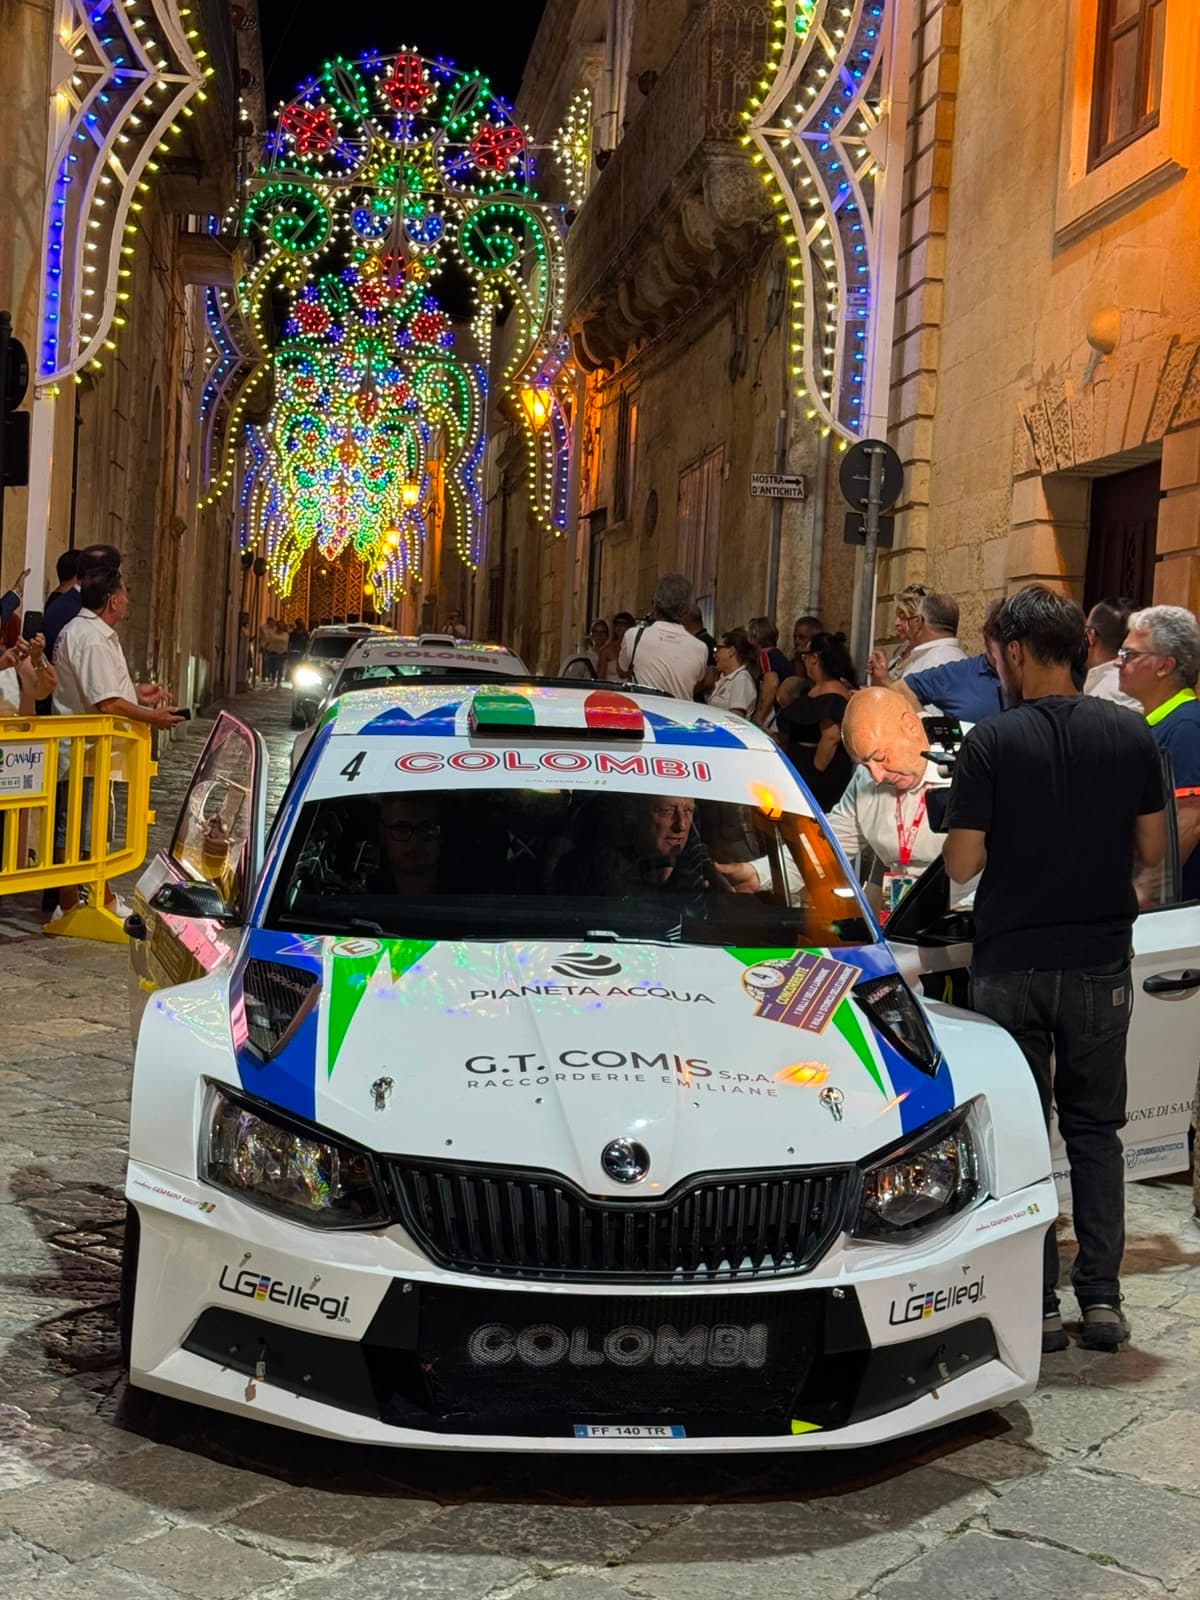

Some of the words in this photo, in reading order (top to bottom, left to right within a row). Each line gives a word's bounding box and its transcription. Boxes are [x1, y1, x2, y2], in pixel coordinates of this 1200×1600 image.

[752, 475, 785, 485] MOSTRA
[361, 650, 370, 659] 5
[384, 651, 499, 665] COLOMBI
[340, 752, 367, 782] 4
[395, 750, 712, 782] COLOMBI
[470, 985, 600, 1000] PIANETA
[606, 986, 715, 1004] ACQUA
[464, 1053, 546, 1075] G.T.
[558, 1050, 713, 1078] COMIS
[719, 1070, 776, 1084] S.p.A.
[467, 1073, 646, 1089] RACCORDERIE
[661, 1075, 778, 1097] EMILIANE
[1125, 1107, 1156, 1121] IGNE
[1156, 1104, 1169, 1117] DI
[1170, 1100, 1195, 1114] SAM
[467, 1322, 768, 1368] COLOMBI
[591, 1426, 609, 1436] FF
[615, 1426, 641, 1436] 140
[645, 1426, 666, 1436] TR
